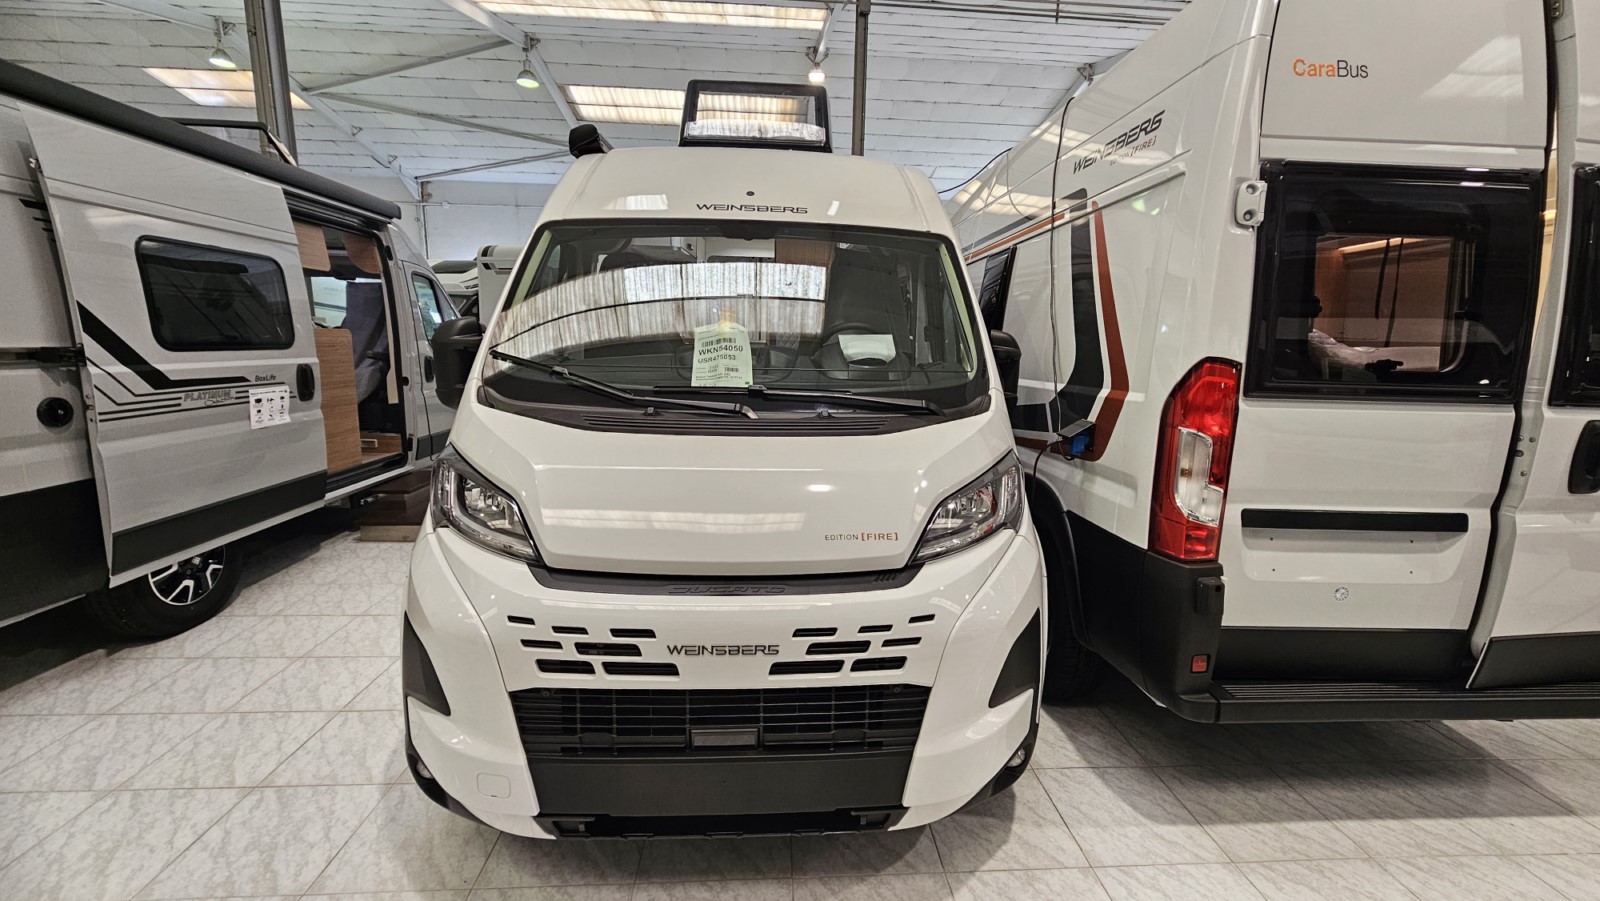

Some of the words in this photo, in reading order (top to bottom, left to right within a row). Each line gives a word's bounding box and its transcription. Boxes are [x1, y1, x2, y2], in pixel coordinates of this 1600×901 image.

[1292, 58, 1369, 79] CaraBus
[1073, 110, 1166, 175] WEINSBERG
[696, 203, 808, 214] WEINSBERG
[698, 344, 744, 356] WKN54050
[254, 374, 277, 382] BoxLife
[183, 388, 232, 402] PLATINUM
[824, 533, 859, 541] EDITION
[860, 532, 899, 542] [FIRE]
[668, 586, 786, 594] DUCATO
[666, 644, 780, 656] WEINSBERG
